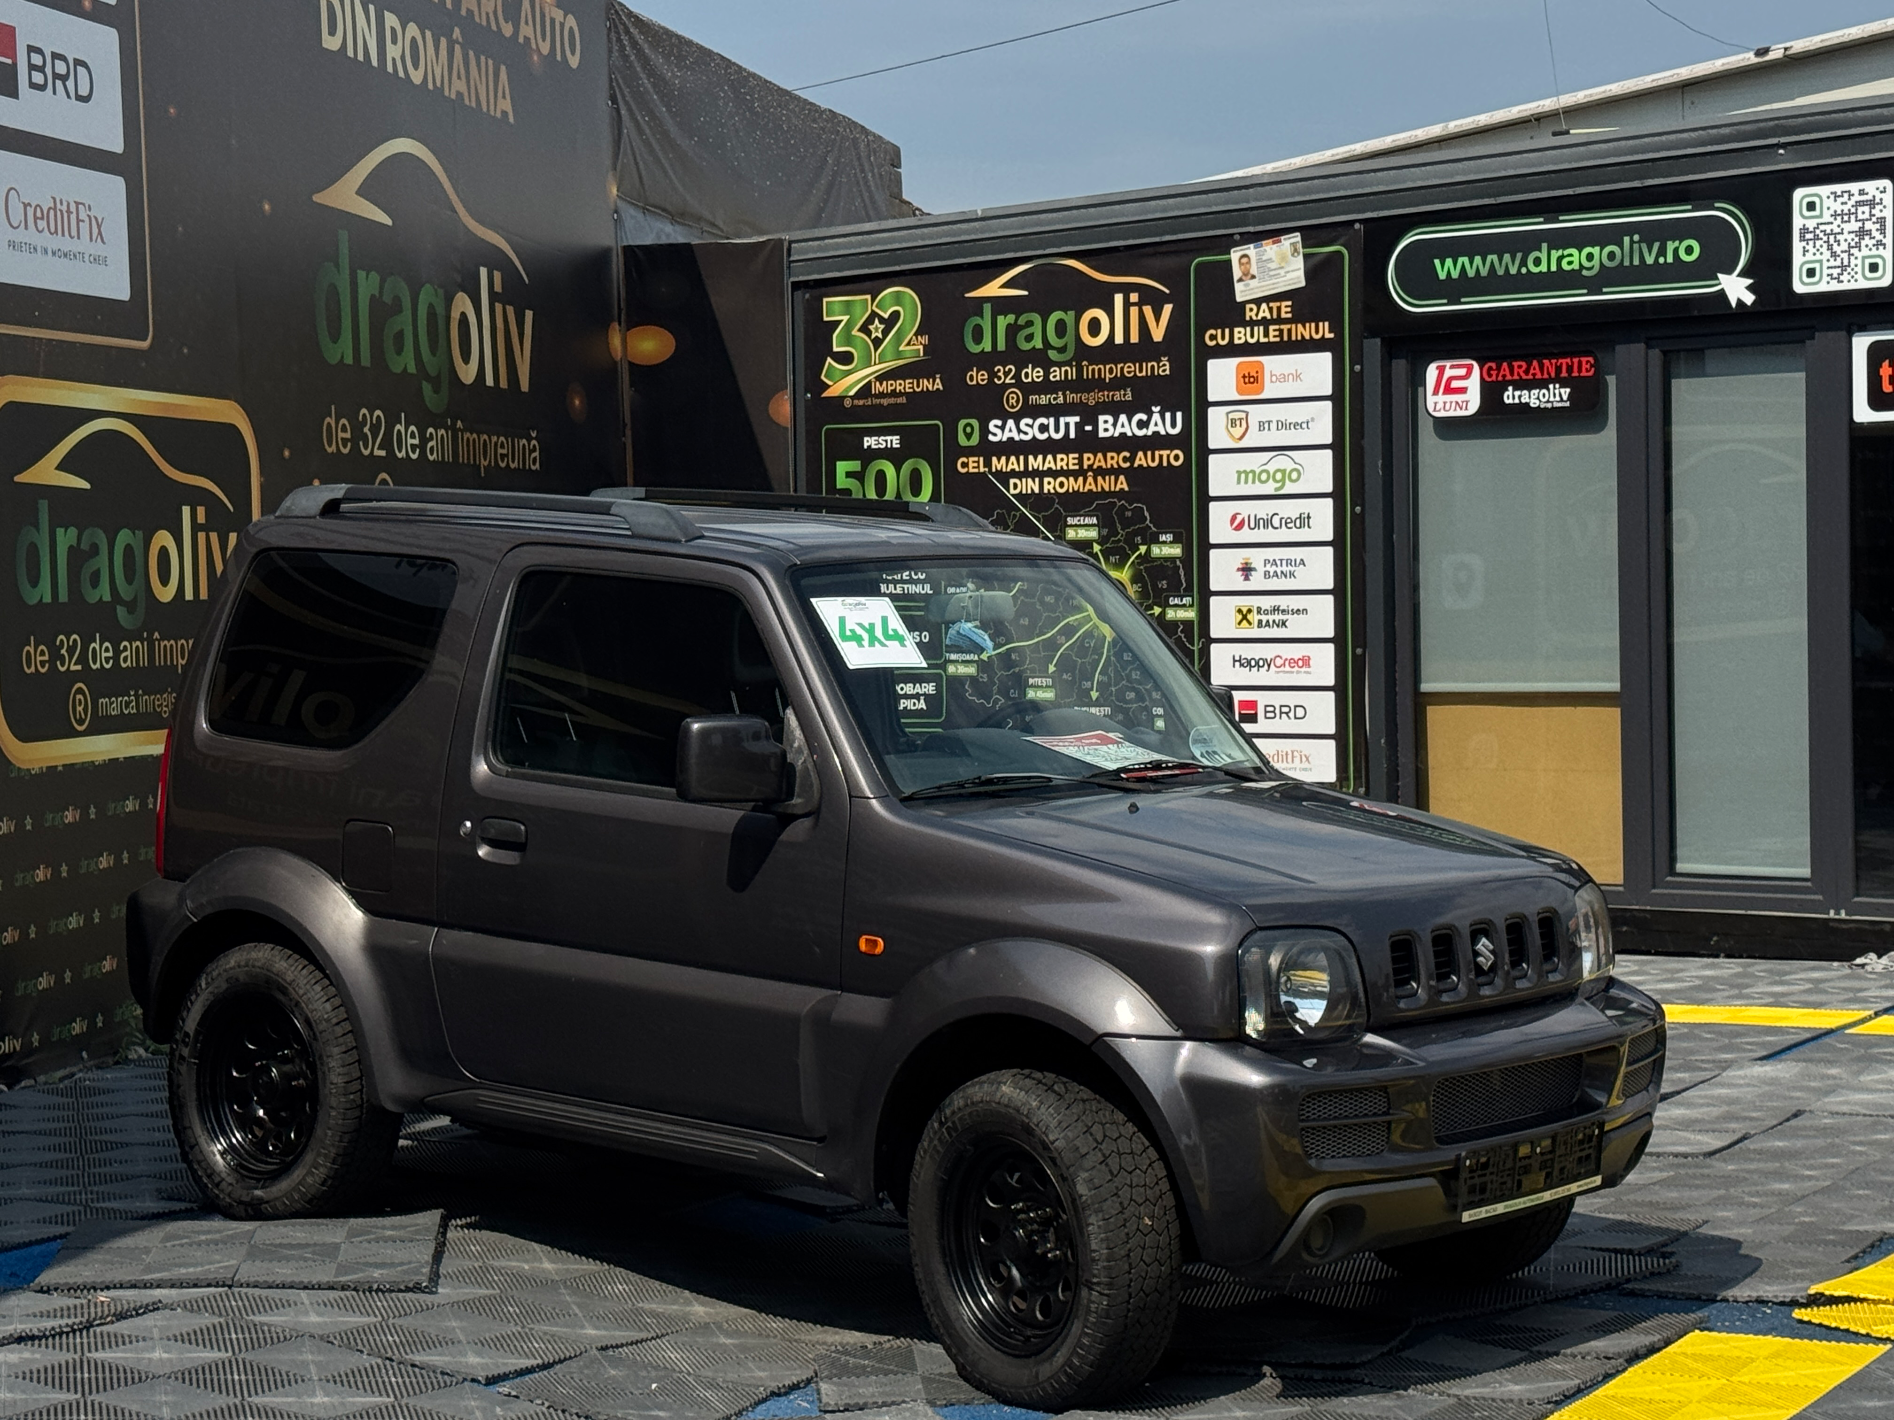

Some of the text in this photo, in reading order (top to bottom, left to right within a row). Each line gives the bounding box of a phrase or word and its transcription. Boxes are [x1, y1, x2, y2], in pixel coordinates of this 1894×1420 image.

[518, 0, 581, 70] AUTO
[26, 44, 94, 104] BRD
[320, 0, 514, 124] DIN ROMÂNIA
[4, 186, 106, 246] CreditFix
[7, 239, 109, 267] PRIETEN IN MOMENTE CHEIE
[1433, 234, 1701, 281] www.dragoliv.ro
[314, 229, 534, 414] dragoliv
[1245, 301, 1293, 321] RATE
[820, 286, 929, 387] 32 ANI
[963, 292, 1174, 363] dragoliv
[1204, 321, 1335, 347] CU BULETINUL
[966, 356, 1171, 386] de 32 de ani împreună
[1241, 369, 1304, 386] tbi bank
[1431, 363, 1475, 397] 12
[1482, 356, 1596, 382] GARANTIE
[871, 373, 944, 396] ÎMPREUNĂ
[1028, 391, 1064, 406] marcă
[1066, 387, 1133, 406] înregistrată
[1503, 383, 1572, 408] dragoliv
[1432, 400, 1471, 413] LUNI
[987, 415, 1081, 442] SASCUT
[1097, 405, 1184, 439] BACĂU
[1229, 416, 1245, 430] BT
[1257, 418, 1274, 433] BT
[322, 404, 540, 478] de 32 de ani împreună
[863, 435, 901, 450] PESTE
[956, 448, 1185, 474] CEL MAI MARE PARC AUTO
[835, 457, 933, 503] 500
[1009, 471, 1129, 495] DIN ROMÂNIA
[1236, 466, 1303, 493] mogo
[1066, 516, 1098, 526] SUCEAVA
[1246, 511, 1313, 531] UniCredit
[1158, 533, 1174, 544] IAȘI
[15, 499, 238, 631] dragoliv
[1262, 557, 1307, 569] PATRIA
[1262, 570, 1297, 580] BANK
[1256, 604, 1308, 618] Raiffeisen
[1256, 618, 1289, 630] BANK
[22, 635, 50, 675] de
[56, 633, 83, 672] 32
[88, 632, 114, 670] de
[119, 631, 148, 668] ani
[1231, 654, 1313, 674] HappyCredit
[98, 689, 137, 717] marcă
[1263, 704, 1307, 721] BRD
